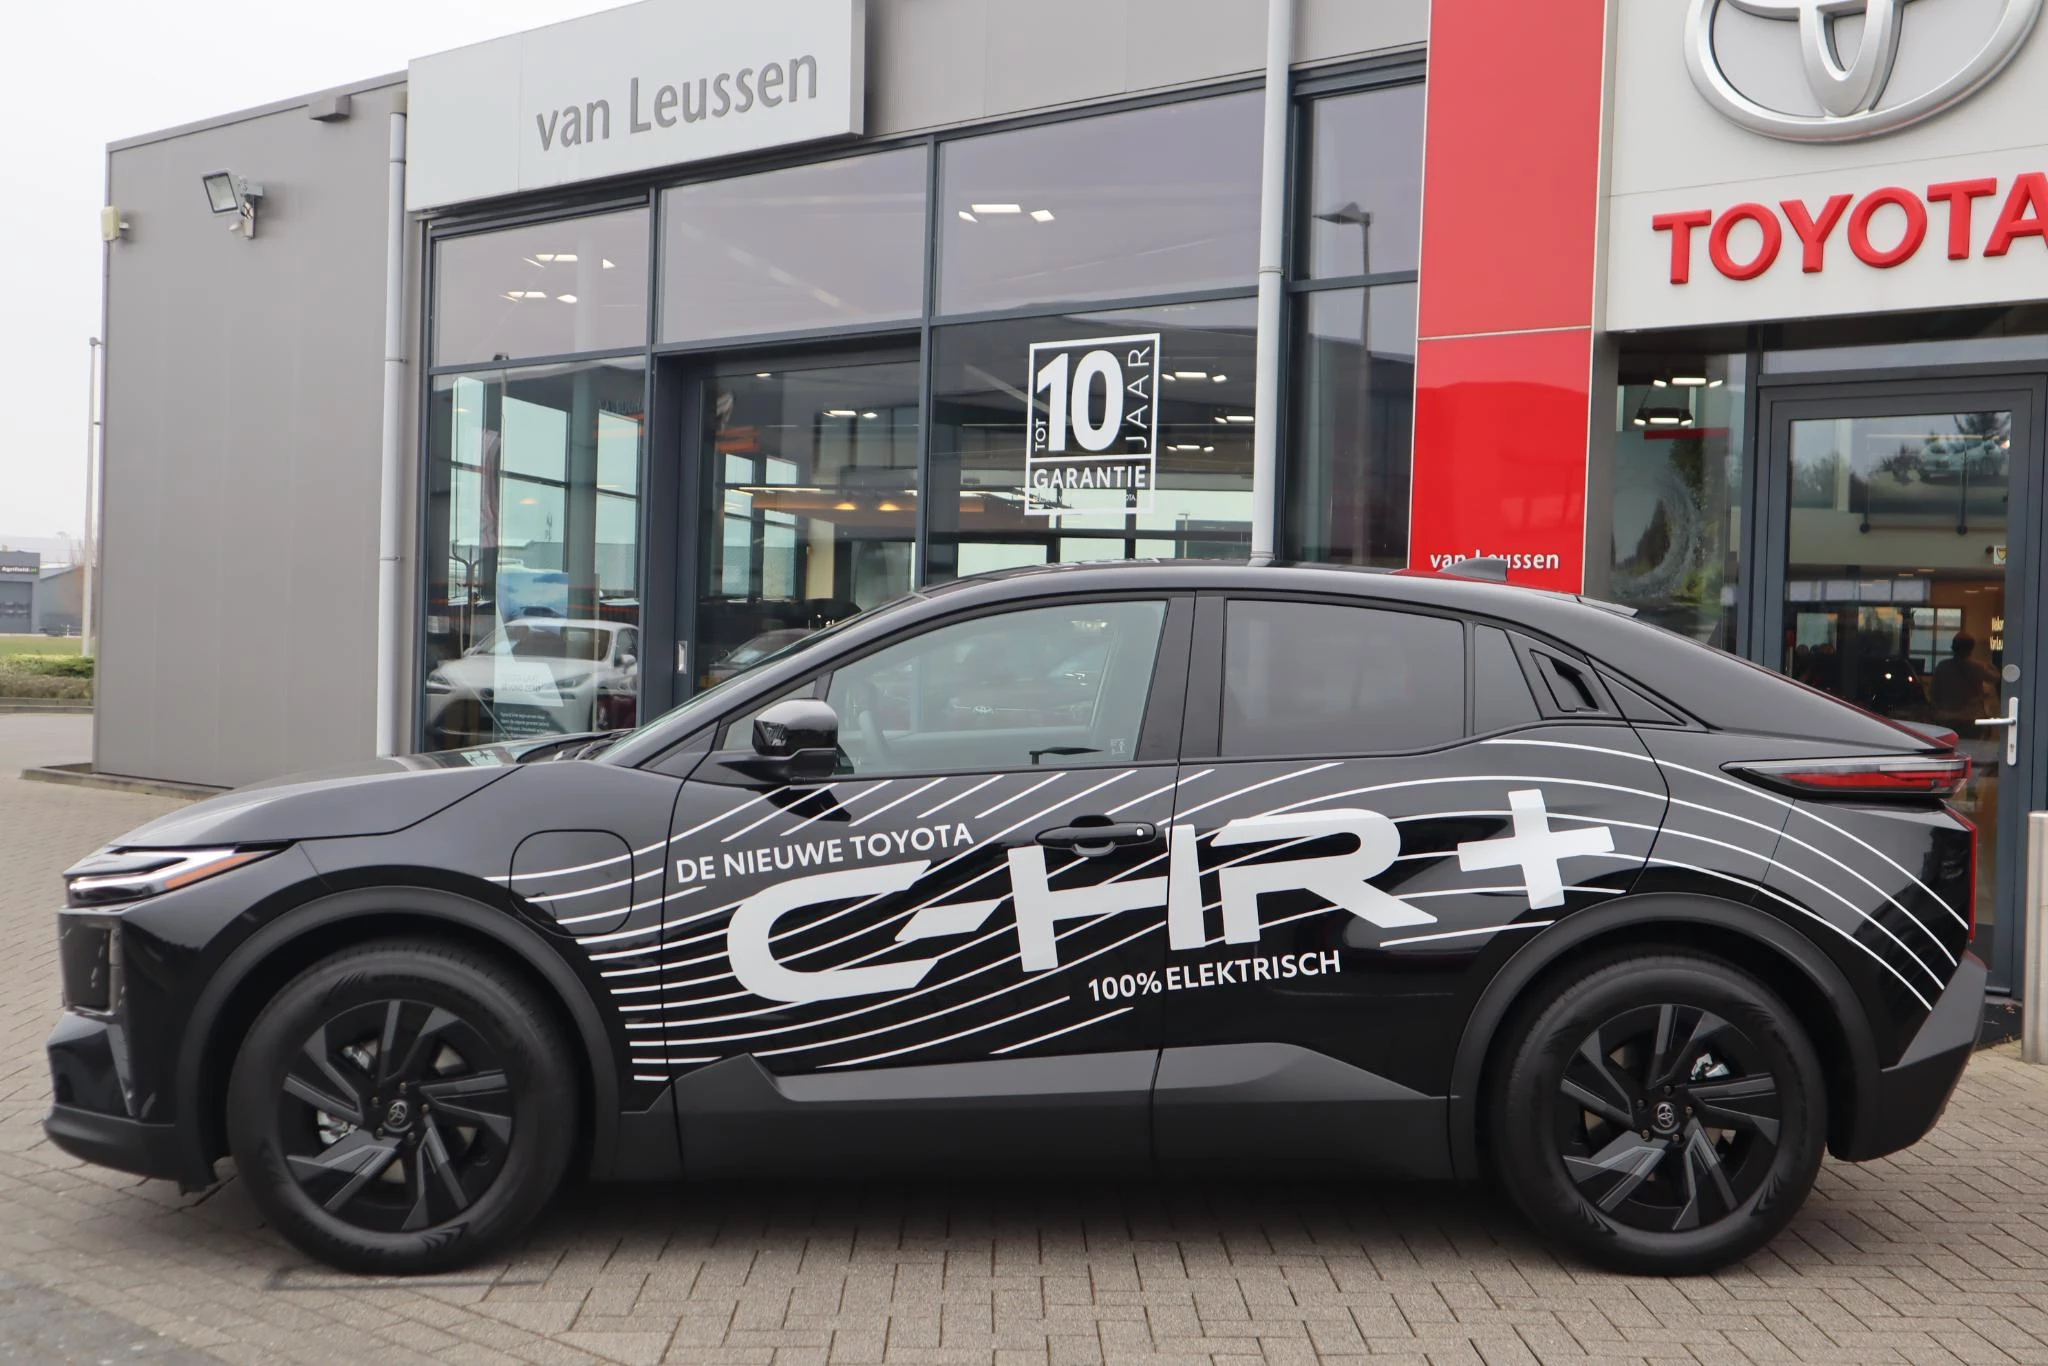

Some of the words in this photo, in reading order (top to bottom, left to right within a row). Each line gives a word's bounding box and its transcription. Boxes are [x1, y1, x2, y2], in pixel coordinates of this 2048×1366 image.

[536, 99, 610, 152] van
[629, 53, 817, 135] Leussen
[1652, 171, 2048, 284] TOYOTA
[1034, 417, 1047, 452] TOT
[1036, 350, 1124, 451] 10
[1125, 346, 1150, 448] JAAR
[1033, 465, 1146, 489] GARANTIE
[676, 855, 717, 883] DE
[724, 838, 843, 877] NIEUWE
[849, 822, 974, 859] TOYOTA
[1088, 971, 1162, 1001] 100%
[1166, 950, 1341, 990] ELEKTRISCH
